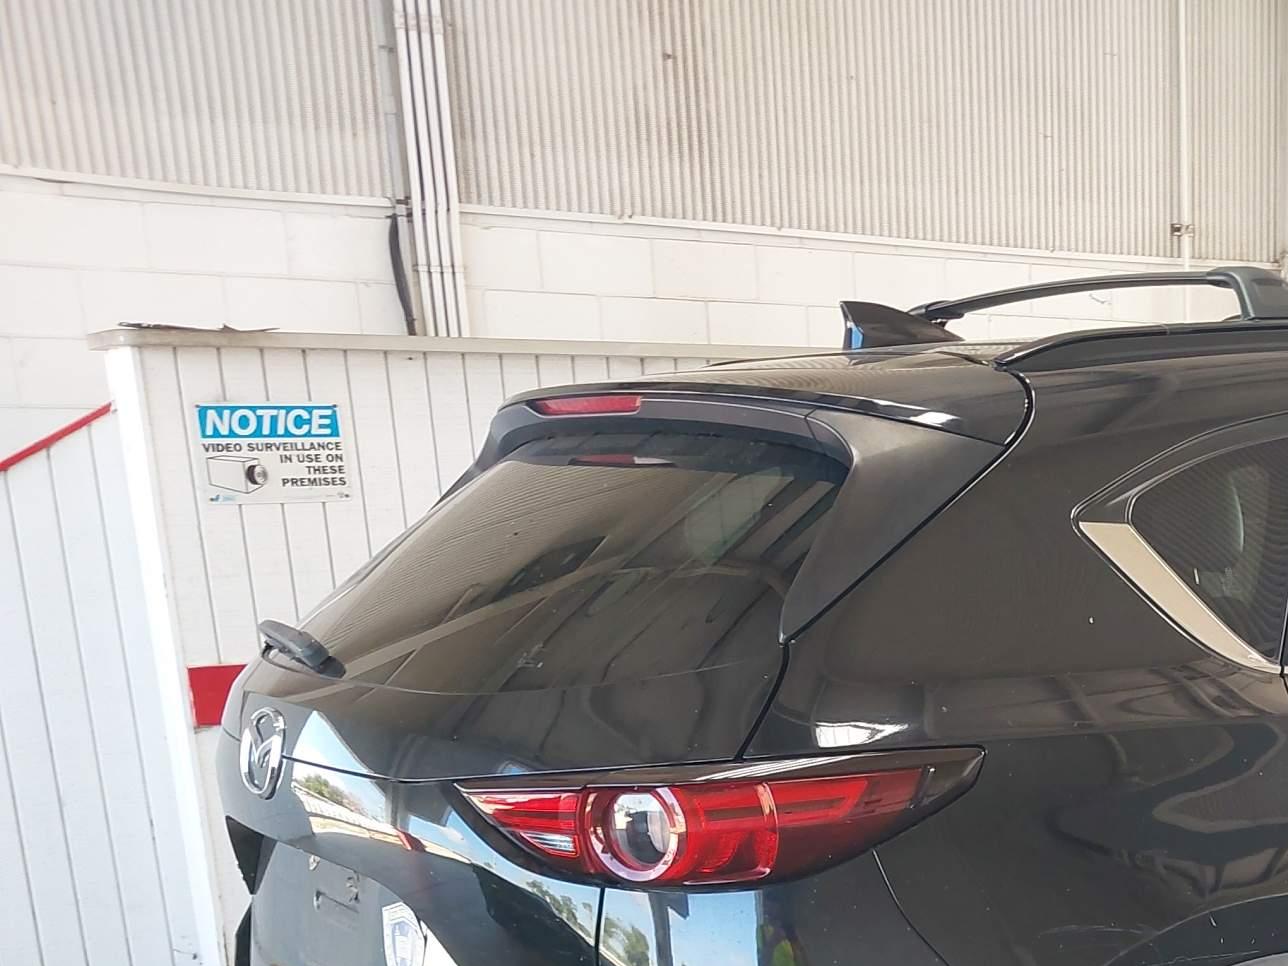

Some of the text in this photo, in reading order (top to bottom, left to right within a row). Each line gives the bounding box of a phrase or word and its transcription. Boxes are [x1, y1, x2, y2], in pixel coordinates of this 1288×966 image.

[205, 409, 332, 436] NOTICE
[202, 441, 342, 452] VIDEO SURVEILLANCE
[280, 453, 343, 463] IN USE ON
[306, 465, 346, 474] THESE
[282, 477, 347, 487] PREMISES
